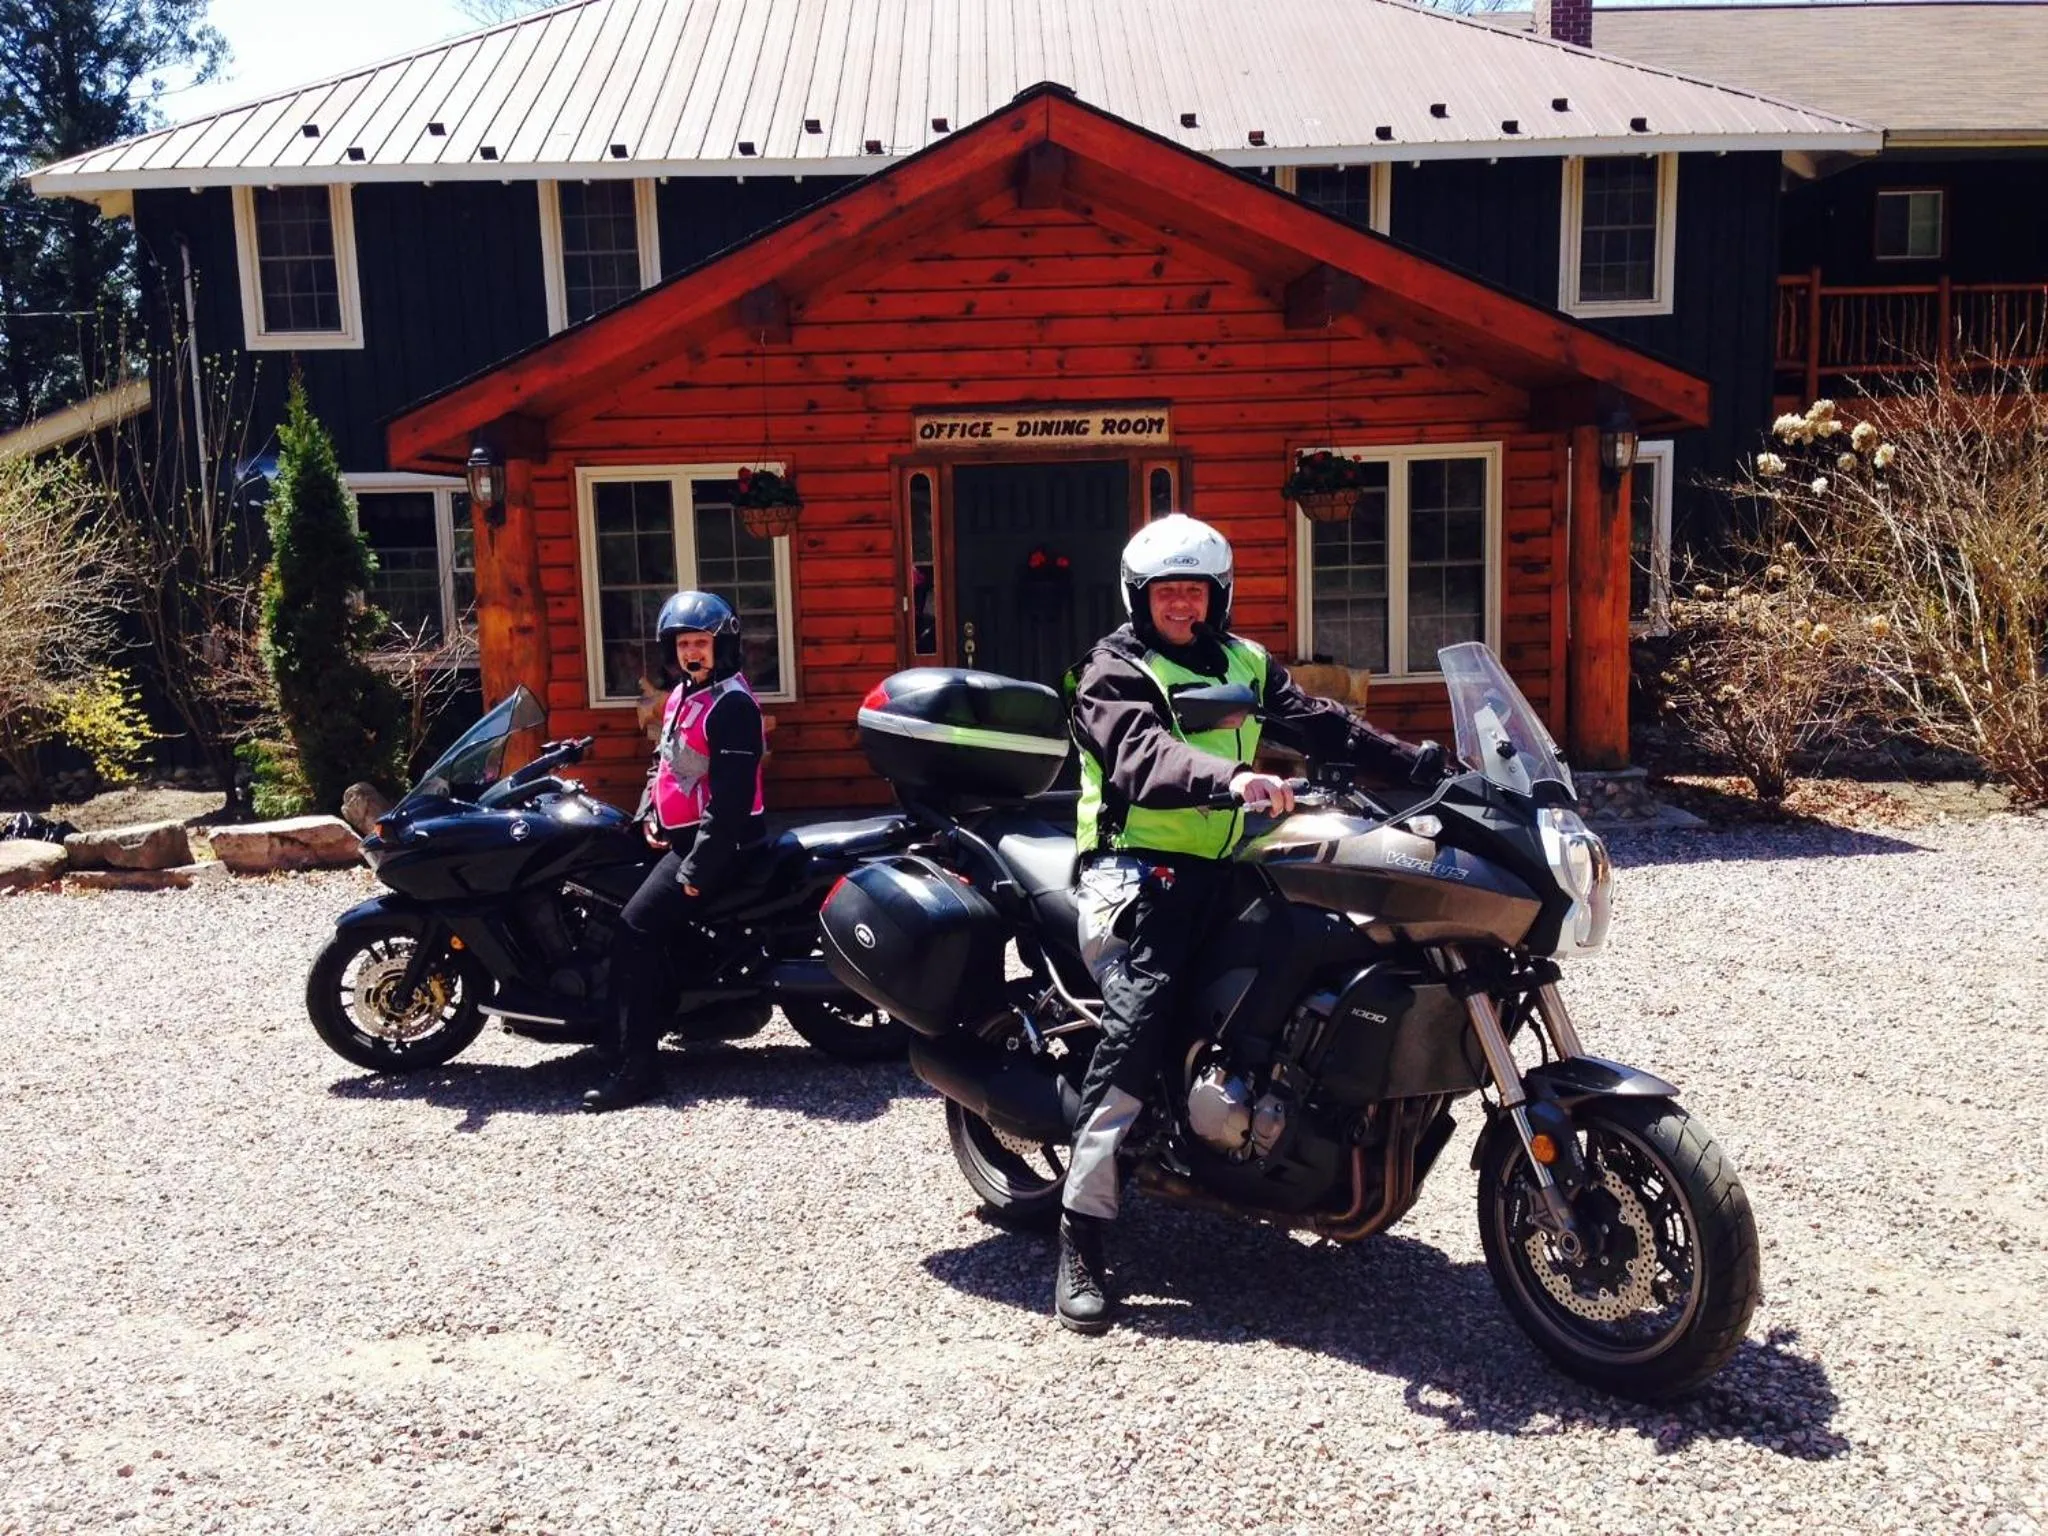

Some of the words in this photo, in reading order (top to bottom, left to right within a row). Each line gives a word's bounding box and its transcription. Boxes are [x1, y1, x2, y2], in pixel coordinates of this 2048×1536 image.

[920, 422, 994, 439] OFFICE
[1015, 419, 1090, 437] DINING
[1101, 417, 1165, 435] ROOM
[1351, 1007, 1388, 1024] 1000
